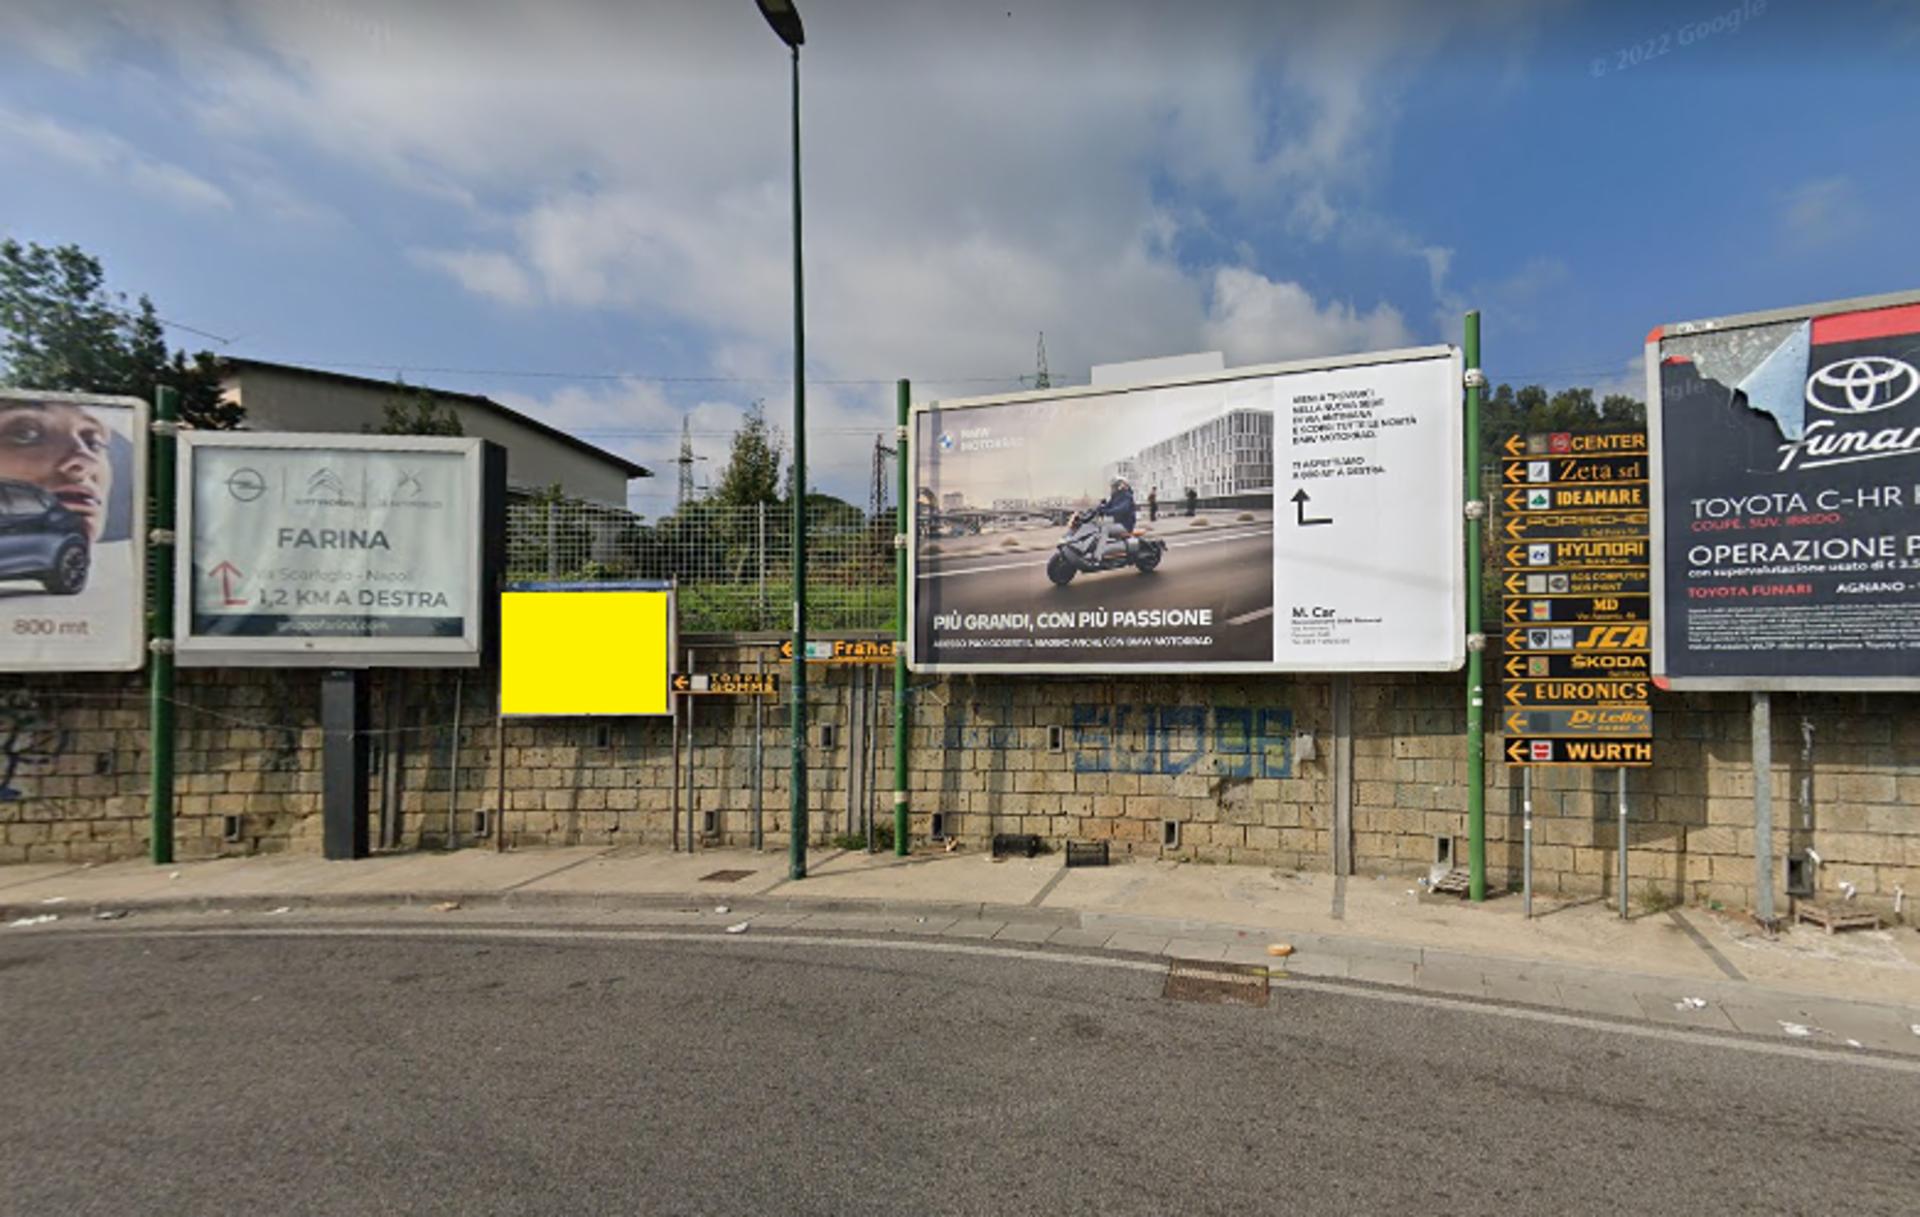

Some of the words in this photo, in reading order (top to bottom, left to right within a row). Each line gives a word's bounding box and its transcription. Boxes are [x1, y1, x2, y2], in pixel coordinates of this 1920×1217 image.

[1571, 434, 1646, 451] CENTER
[1560, 460, 1611, 481] Zeta
[1618, 461, 1640, 478] srl
[1557, 489, 1642, 506] IDEAMARE
[1691, 493, 1808, 519] TOYOTA
[1816, 486, 1903, 511] C-HR
[277, 526, 391, 551] FARINA
[1558, 542, 1644, 557] HYUNDAI
[1688, 536, 1898, 566] OPERAZIONE
[1688, 569, 1711, 579] con
[1713, 563, 1825, 579] supervalutazione
[1829, 561, 1868, 573] usato
[1870, 560, 1885, 571] di
[297, 589, 330, 606] KM
[335, 590, 352, 606] A
[359, 589, 449, 608] DESTRA
[1688, 585, 1749, 599] TOYOTA
[1752, 583, 1813, 597] FUNARI
[1835, 581, 1905, 595] AGNANO
[1312, 606, 1336, 618] Car
[1592, 600, 1618, 611] MD
[13, 619, 54, 635] 800
[60, 620, 88, 635] mt
[933, 610, 961, 631] PIÙ
[964, 612, 1035, 632] GRANDI,
[1037, 611, 1075, 629] CON
[1079, 607, 1107, 628] PIÙ
[1113, 608, 1213, 627] PASSIONE
[1571, 653, 1647, 668] ŠKODA
[1536, 682, 1648, 700] EURONICS
[1566, 742, 1651, 760] WURTH
